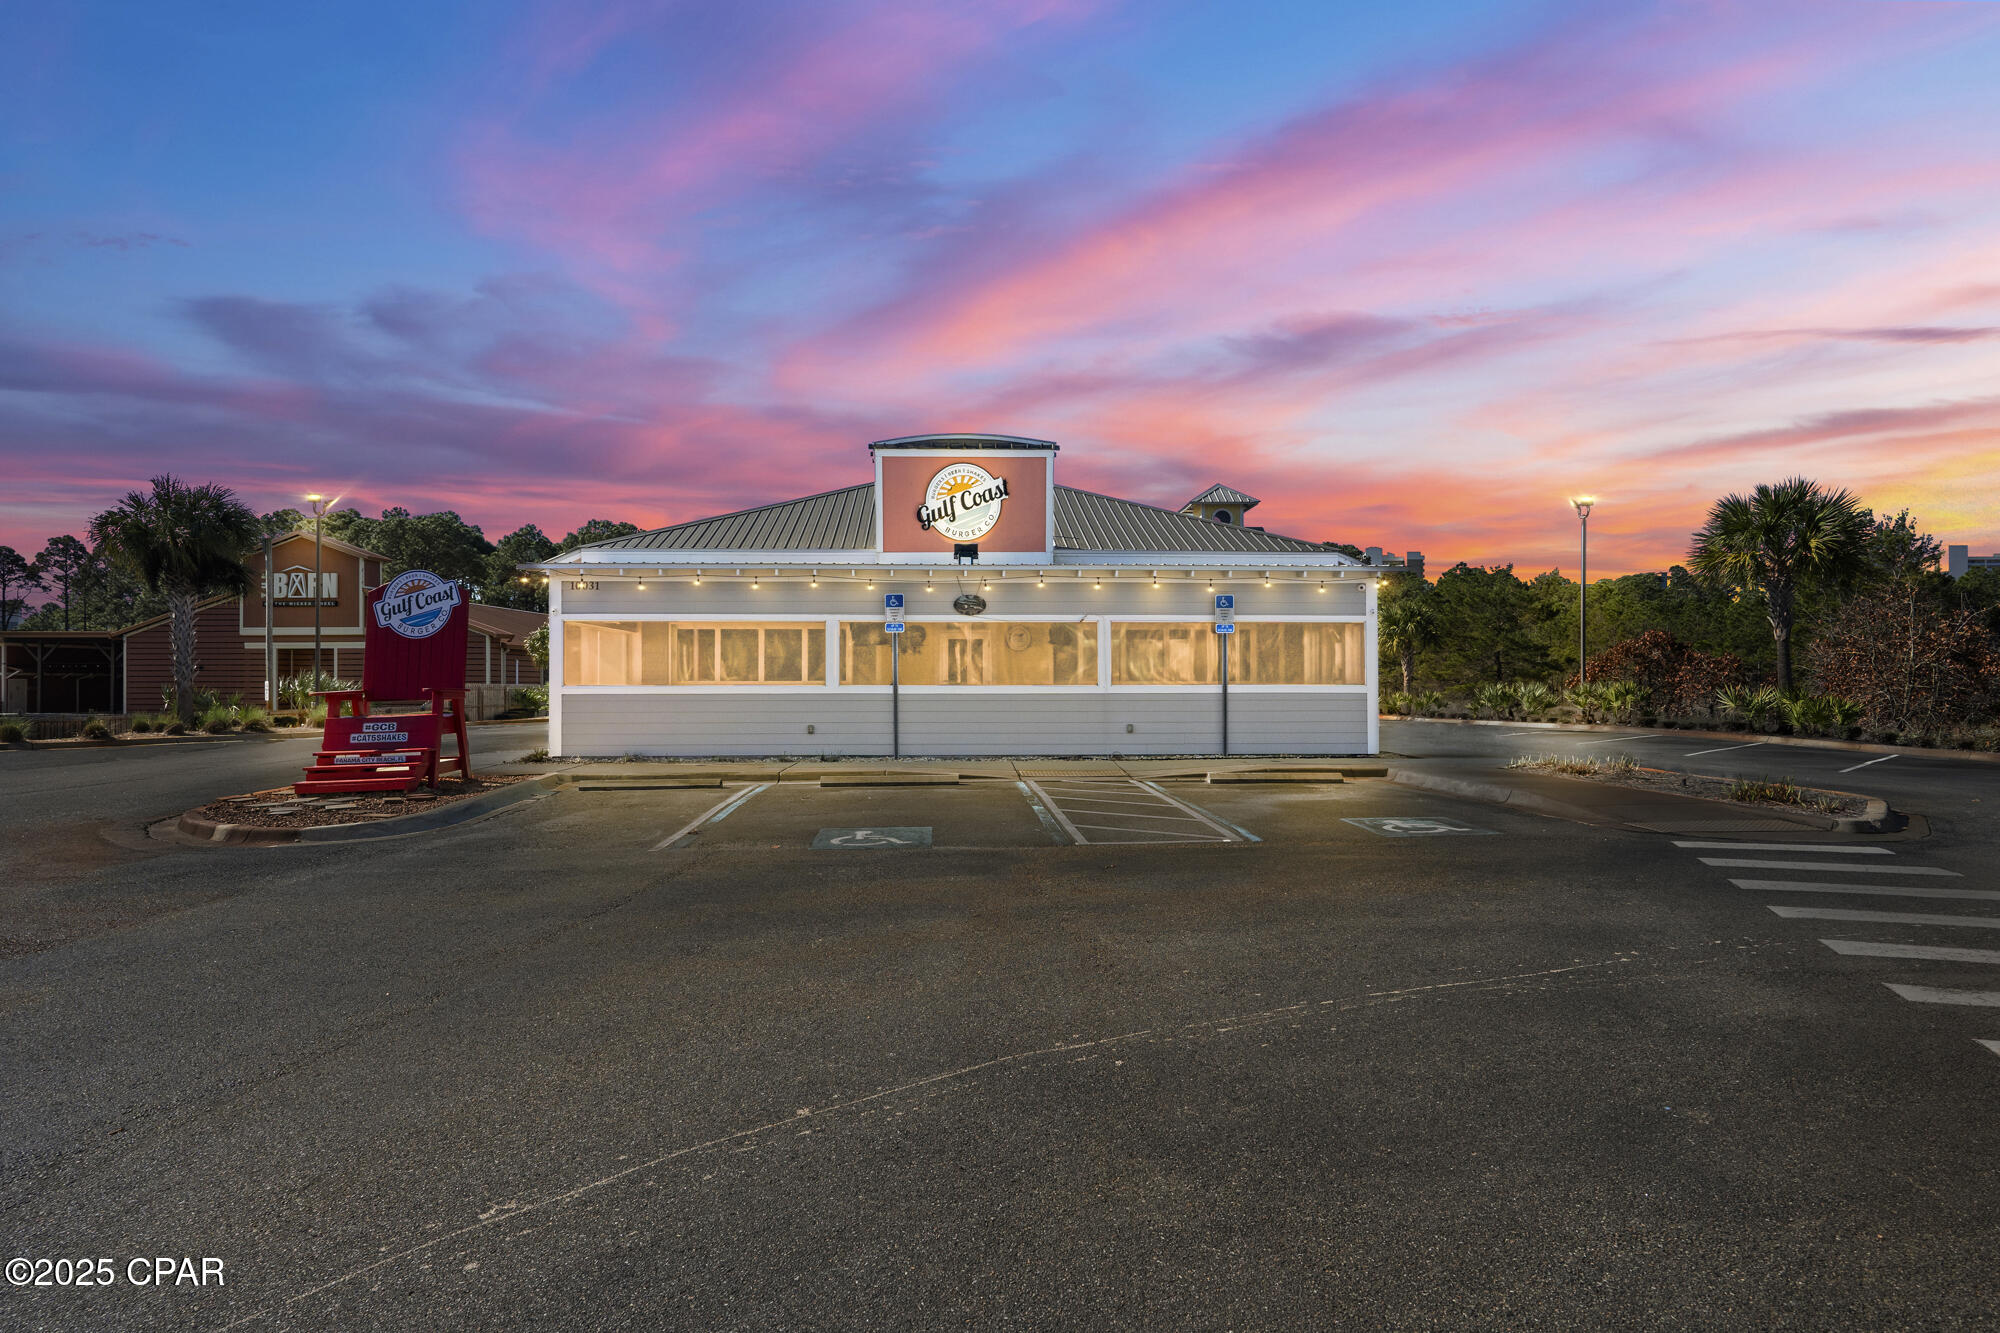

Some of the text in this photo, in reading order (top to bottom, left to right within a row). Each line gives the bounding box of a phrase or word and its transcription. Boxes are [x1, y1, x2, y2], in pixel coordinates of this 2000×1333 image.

[917, 479, 1009, 531] Gulf Coast
[944, 526, 983, 538] BURGER
[380, 585, 454, 622] Gulf Coast
[397, 623, 437, 635] BURGER
[365, 723, 396, 731] #GCB
[351, 733, 407, 742] #CAT5SHAKES
